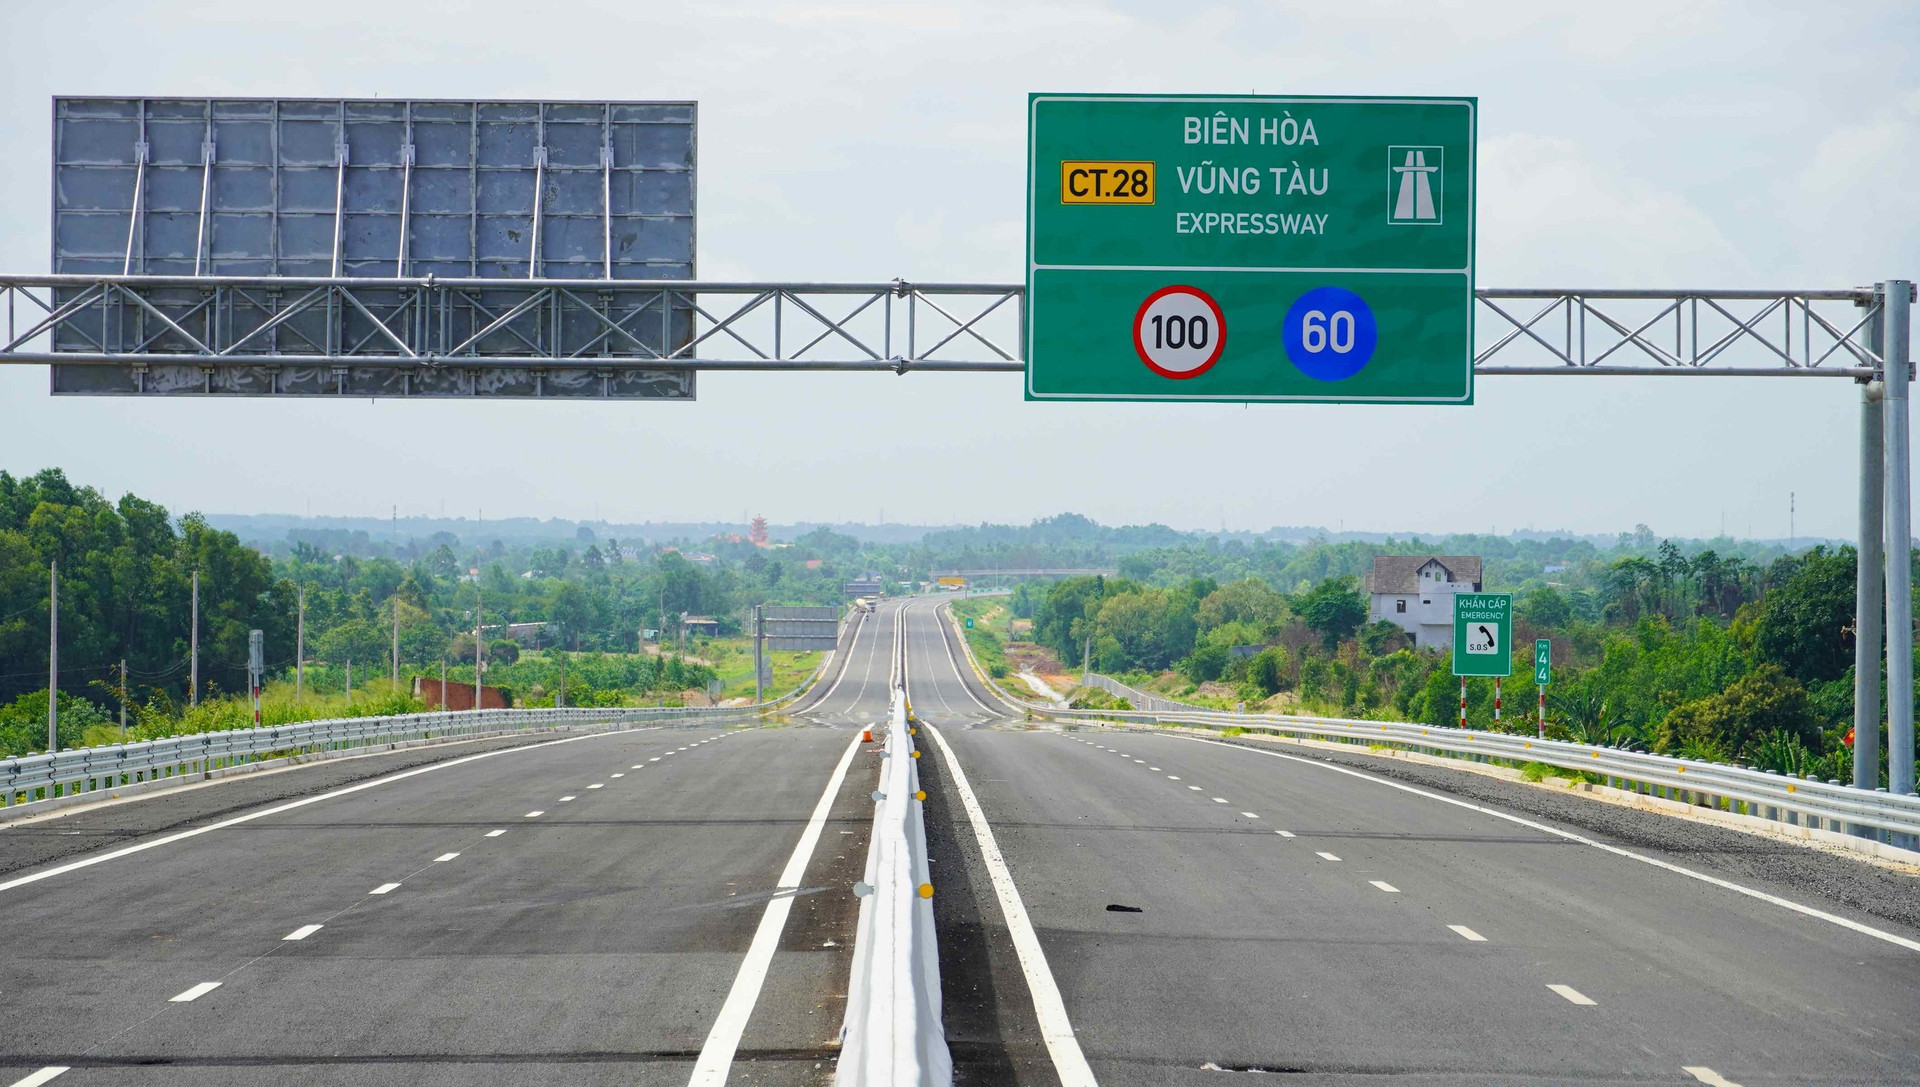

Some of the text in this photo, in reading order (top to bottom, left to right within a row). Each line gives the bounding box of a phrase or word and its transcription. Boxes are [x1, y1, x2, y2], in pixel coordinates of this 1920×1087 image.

[1183, 111, 1319, 145] BIÊN HÒA
[1068, 168, 1148, 197] CT.28
[1177, 160, 1329, 196] VŨNG TÀU
[1176, 212, 1329, 235] EXPRESSWAY
[1151, 315, 1208, 350] 100
[1302, 309, 1355, 354] 60
[1488, 597, 1506, 609] CẤP
